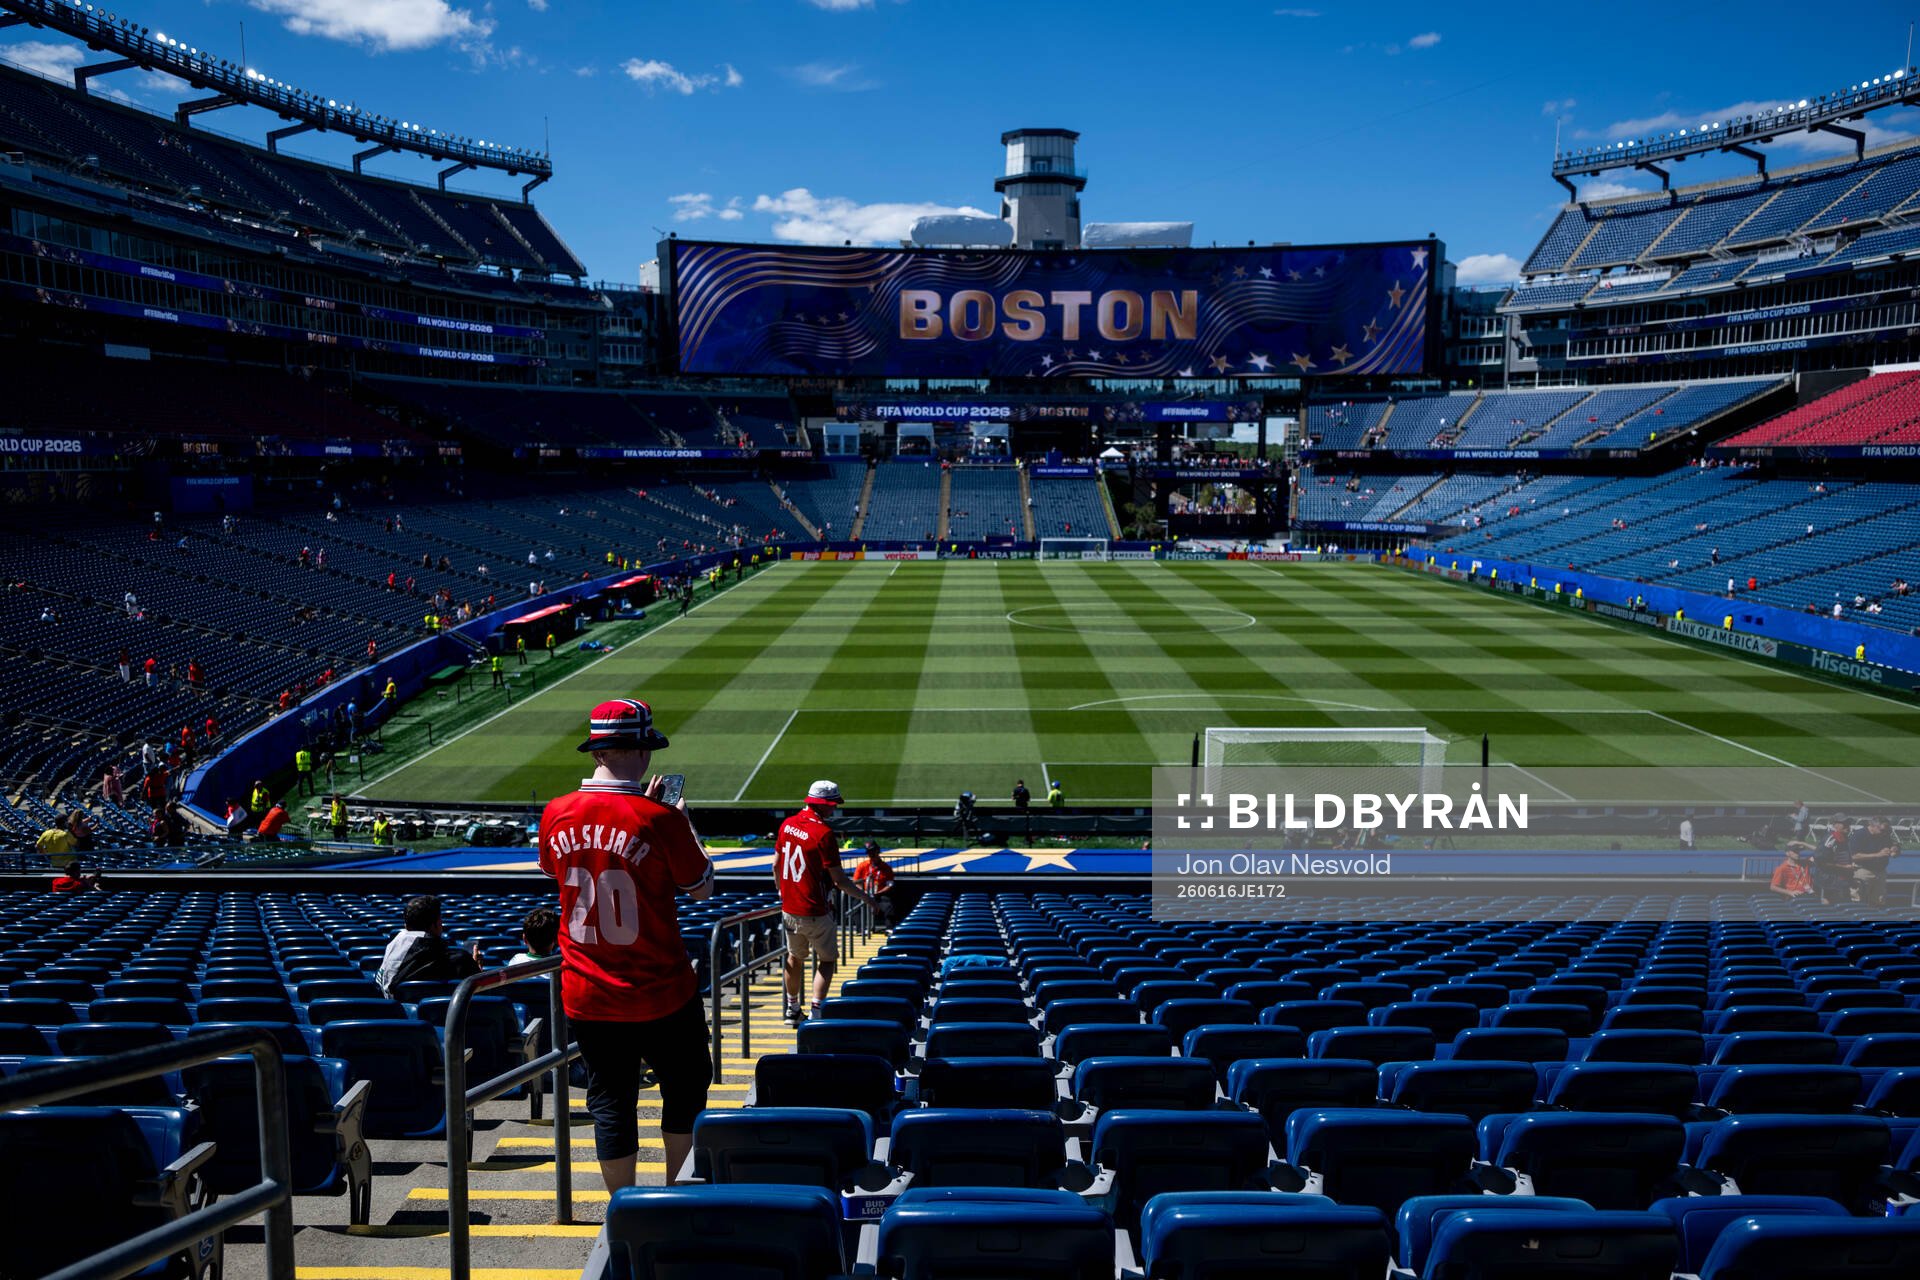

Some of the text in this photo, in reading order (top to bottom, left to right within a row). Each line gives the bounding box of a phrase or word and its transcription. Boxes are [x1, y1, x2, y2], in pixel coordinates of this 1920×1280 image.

[900, 289, 1199, 341] BOSTON
[1727, 304, 1811, 323] FIFA WORLD CUP 2026
[418, 316, 494, 334] FIFA WORLD CUP 2026
[419, 347, 495, 363] FIFA WORLD CUP 2026
[1724, 340, 1808, 356] FIFA WORLD CUP 2026
[876, 406, 1011, 417] FIFA WORLD CUP 2026
[1039, 406, 1089, 417] BOSTON
[20, 438, 43, 452] CUP
[44, 439, 83, 453] 2026
[1862, 446, 1881, 457] FIFA
[1882, 446, 1914, 457] WORLD
[623, 450, 702, 458] FIFA WORLD CUP 2026
[1454, 450, 1540, 459] FIFA WORLD CUP 2026
[1345, 522, 1427, 533] FIFA WORLD CUP 2026
[884, 552, 918, 560] verizon
[1166, 551, 1216, 560] Hisense
[1670, 620, 1760, 652] BANK OF AMERICA
[1811, 650, 1882, 684] Hisense
[550, 824, 650, 866] SOLSKJAER
[782, 841, 806, 882] 10
[564, 867, 639, 945] 20
[865, 1200, 885, 1208] BUD
